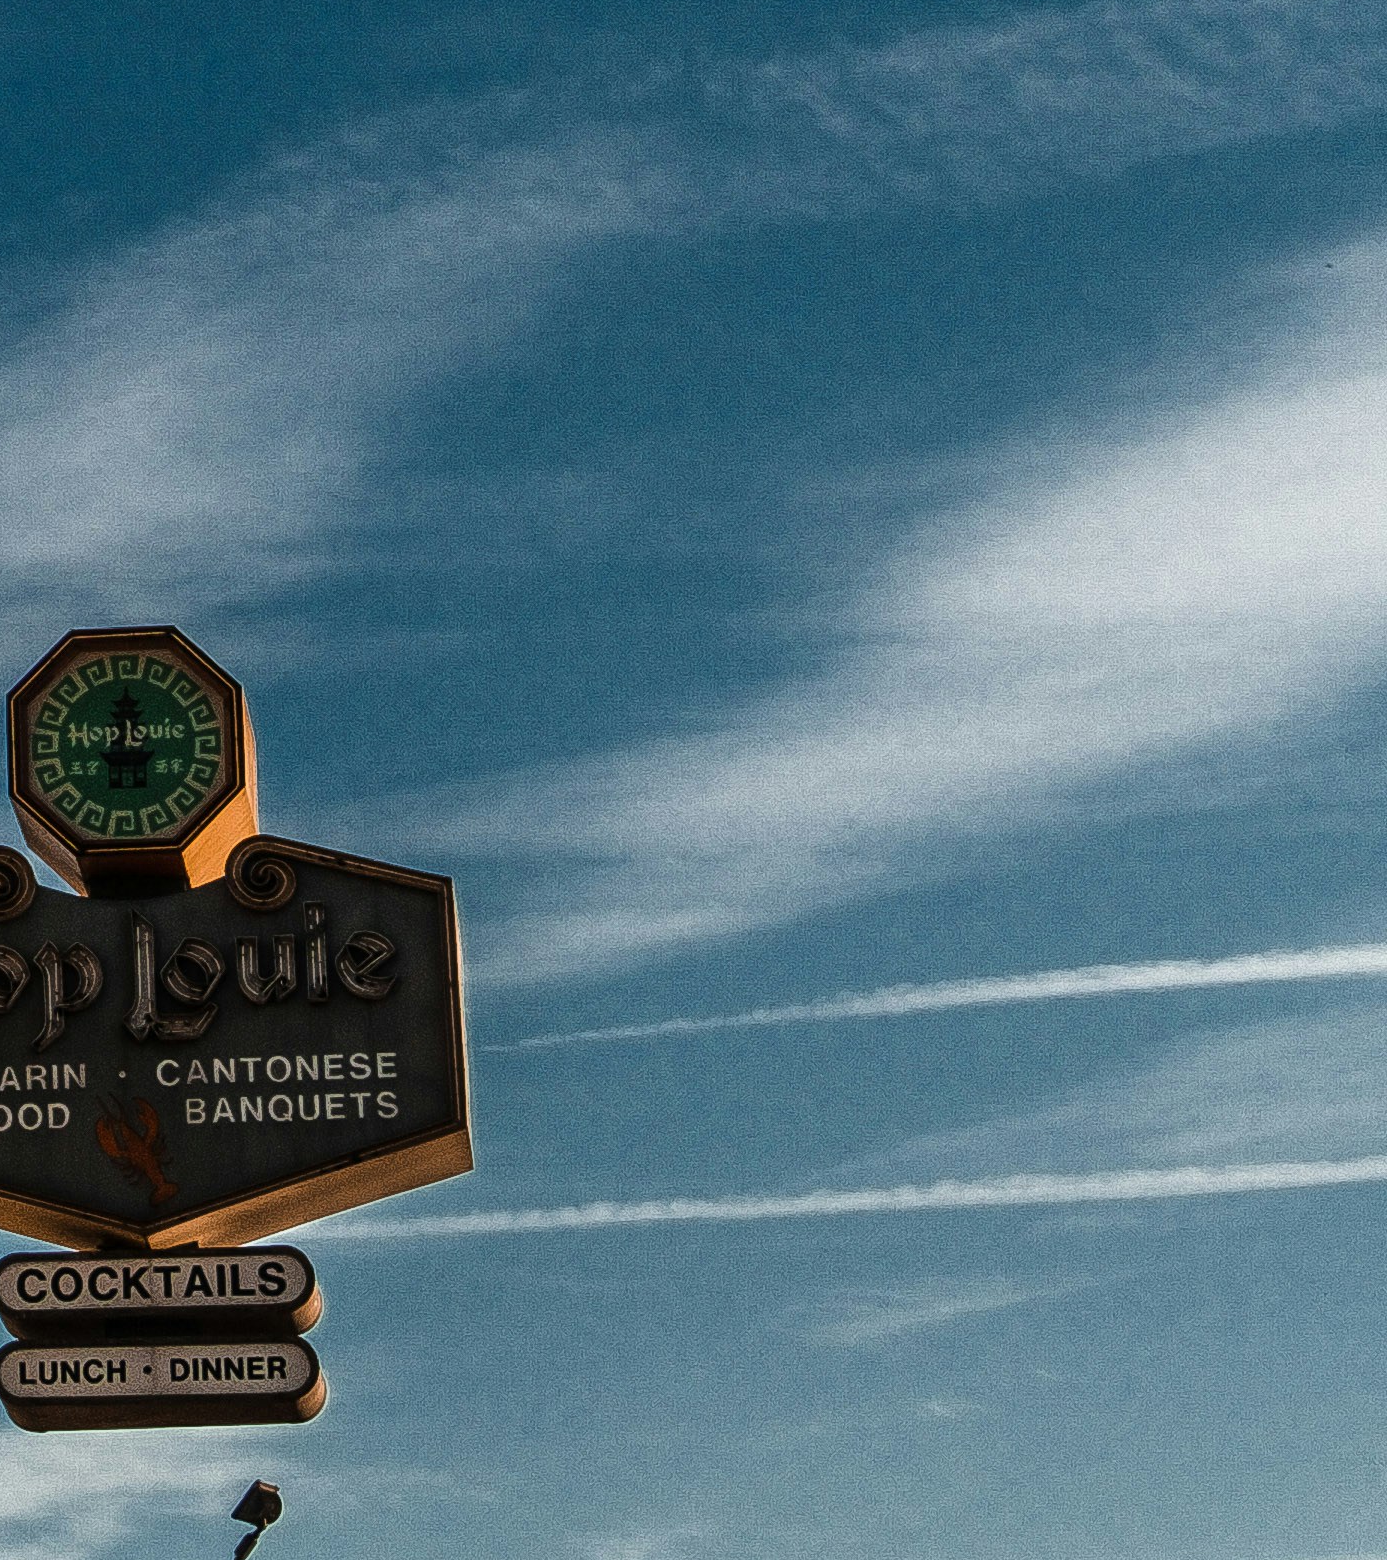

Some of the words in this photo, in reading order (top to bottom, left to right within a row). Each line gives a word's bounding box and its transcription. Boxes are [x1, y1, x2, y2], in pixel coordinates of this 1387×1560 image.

[67, 721, 120, 749] Hop
[124, 717, 186, 748] Louie
[121, 900, 400, 1046] Louie
[155, 1051, 400, 1088] CANTONESE
[184, 1090, 401, 1126] BANQUETS
[16, 1260, 288, 1304] COCKTAILS
[18, 1359, 127, 1387] LUNCH
[168, 1355, 288, 1384] DINNER
